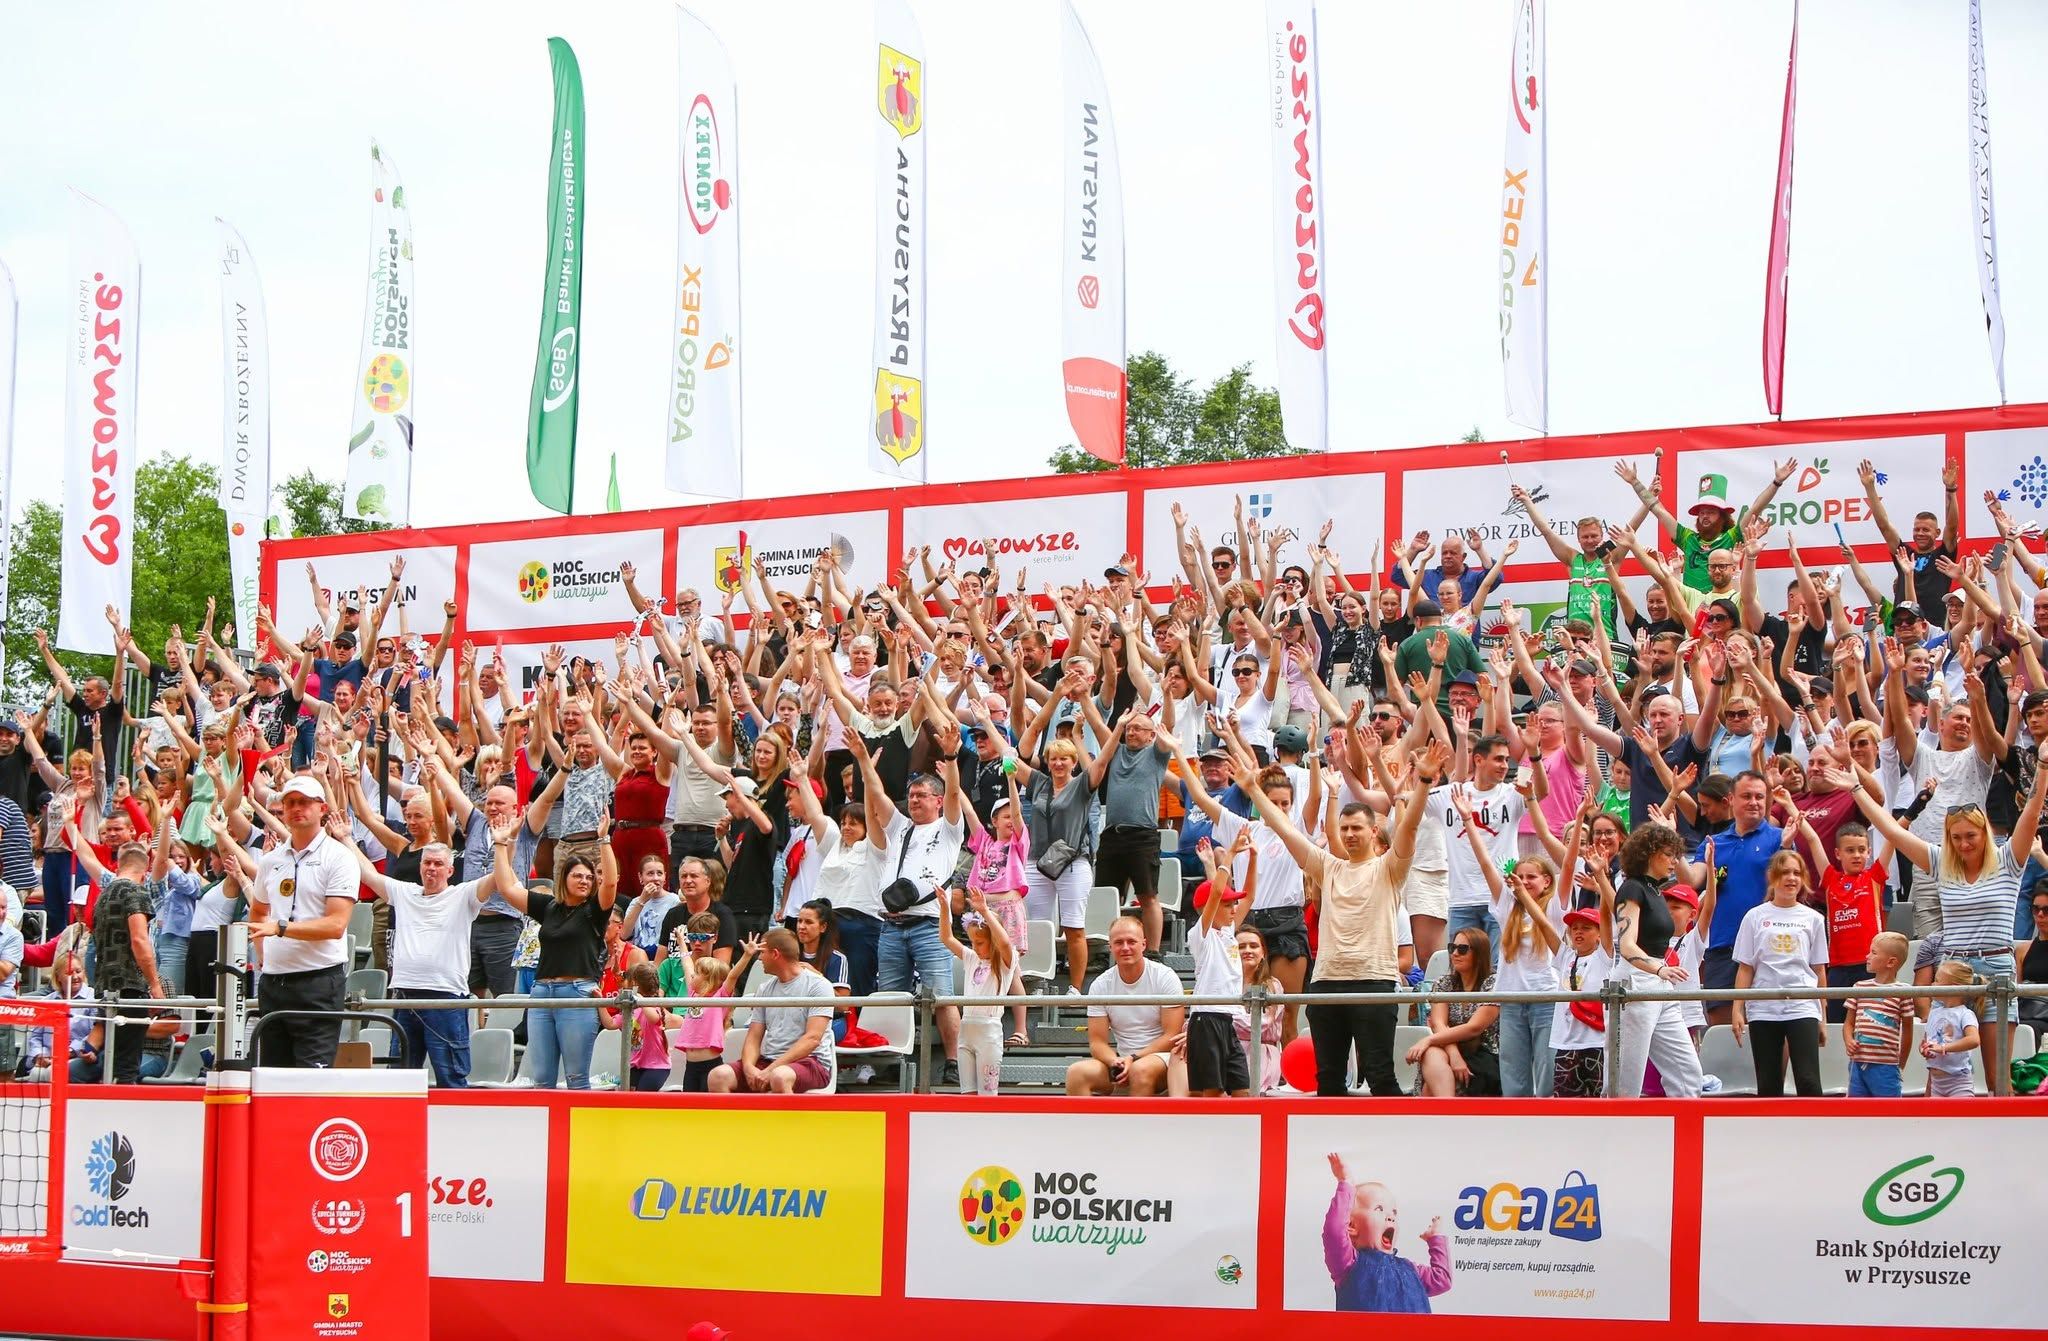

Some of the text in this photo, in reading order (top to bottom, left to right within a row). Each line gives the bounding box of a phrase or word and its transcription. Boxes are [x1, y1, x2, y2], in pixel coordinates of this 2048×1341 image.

[1508, 518, 1609, 539] ZBOŻENA
[553, 560, 584, 573] MOC
[759, 549, 794, 562] GMINA
[552, 570, 621, 587] POLSKICH
[427, 1176, 493, 1208] sze.
[1034, 1171, 1097, 1195] MOC
[1888, 1182, 1940, 1203] SGB
[679, 1183, 827, 1218] LEWIATAN
[1033, 1198, 1173, 1222] POLSKICH
[70, 1205, 149, 1228] ColdTech
[396, 1192, 412, 1237] 1
[456, 1211, 485, 1224] Polski
[1554, 1196, 1597, 1229] 24
[1032, 1223, 1147, 1255] warzyw
[1454, 1236, 1542, 1248] Twoje najlepsze zakupy
[330, 1257, 371, 1265] POLSKICH
[1816, 1239, 2002, 1264] Bank Spółdzielczy
[1455, 1260, 1596, 1275] Wybieraj sercem, kupuj rozsądnie.
[1845, 1266, 1971, 1289] w Przysusze
[1534, 1288, 1595, 1300] www.aga24.pl
